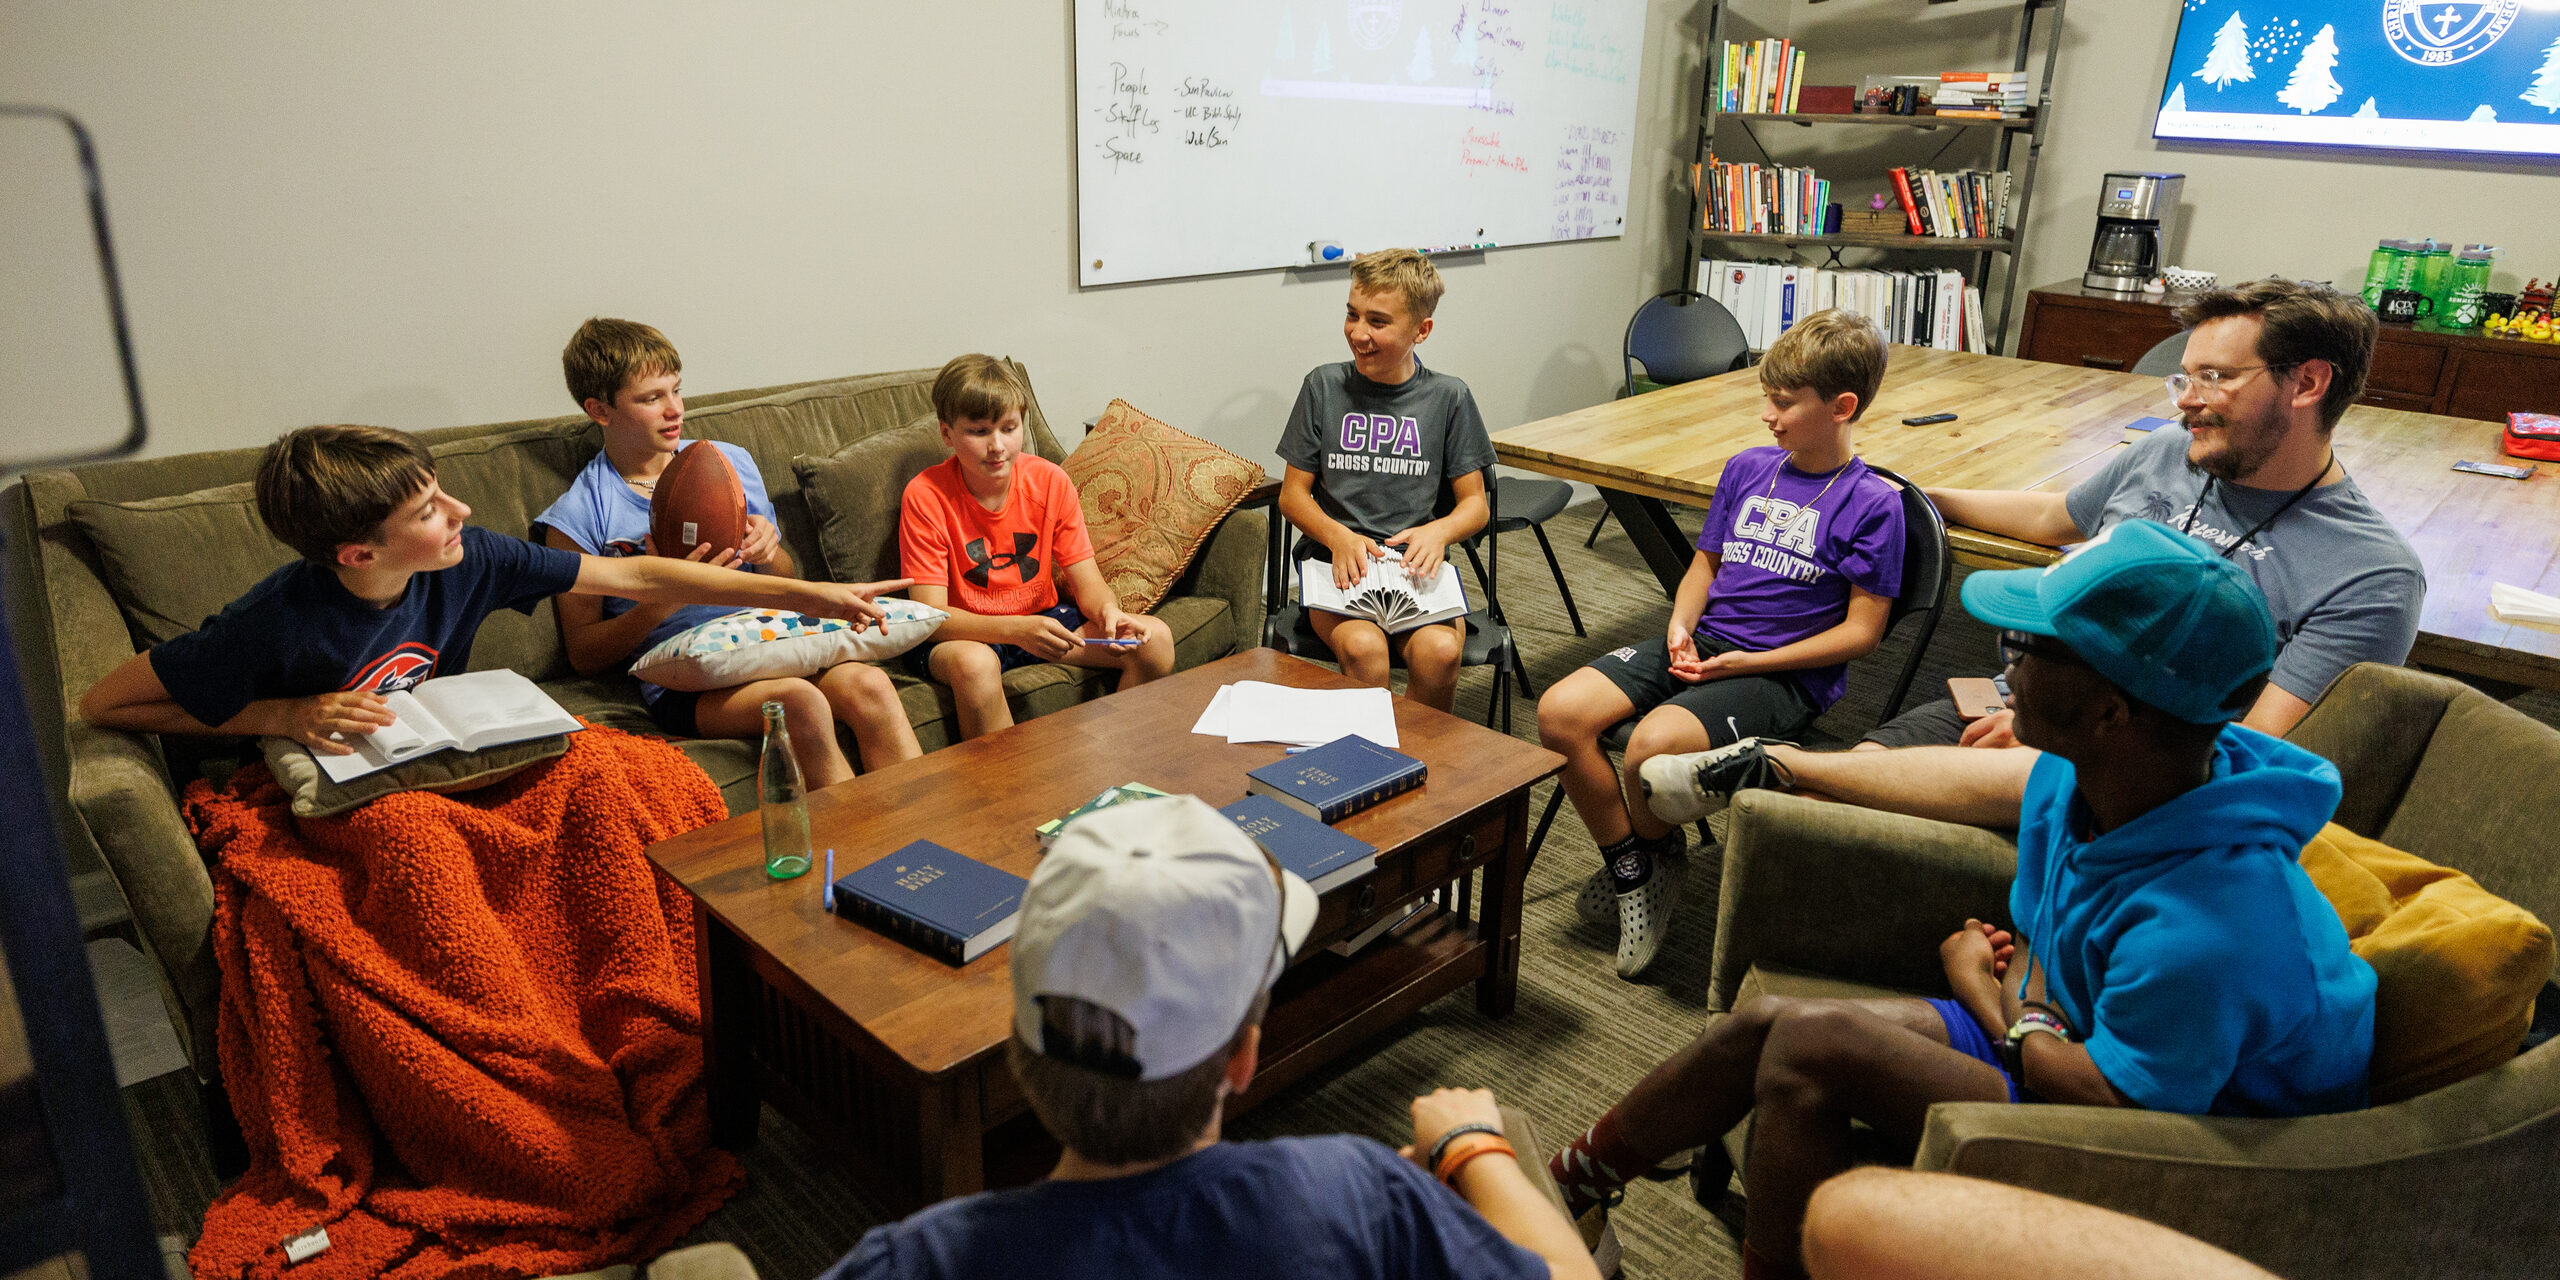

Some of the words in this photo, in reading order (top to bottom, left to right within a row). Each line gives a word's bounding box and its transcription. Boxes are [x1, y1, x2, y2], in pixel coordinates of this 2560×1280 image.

[2421, 50, 2454, 62] 1985
[1340, 412, 1422, 457] CPA
[1328, 453, 1370, 472] CROSS
[1373, 456, 1431, 477] COUNTRY
[1733, 495, 1821, 559] CPA
[1750, 544, 1827, 585] COUNTRY
[1247, 821, 1283, 839] BIBLE
[895, 863, 936, 887] HOLY
[906, 869, 947, 892] BIBLE
